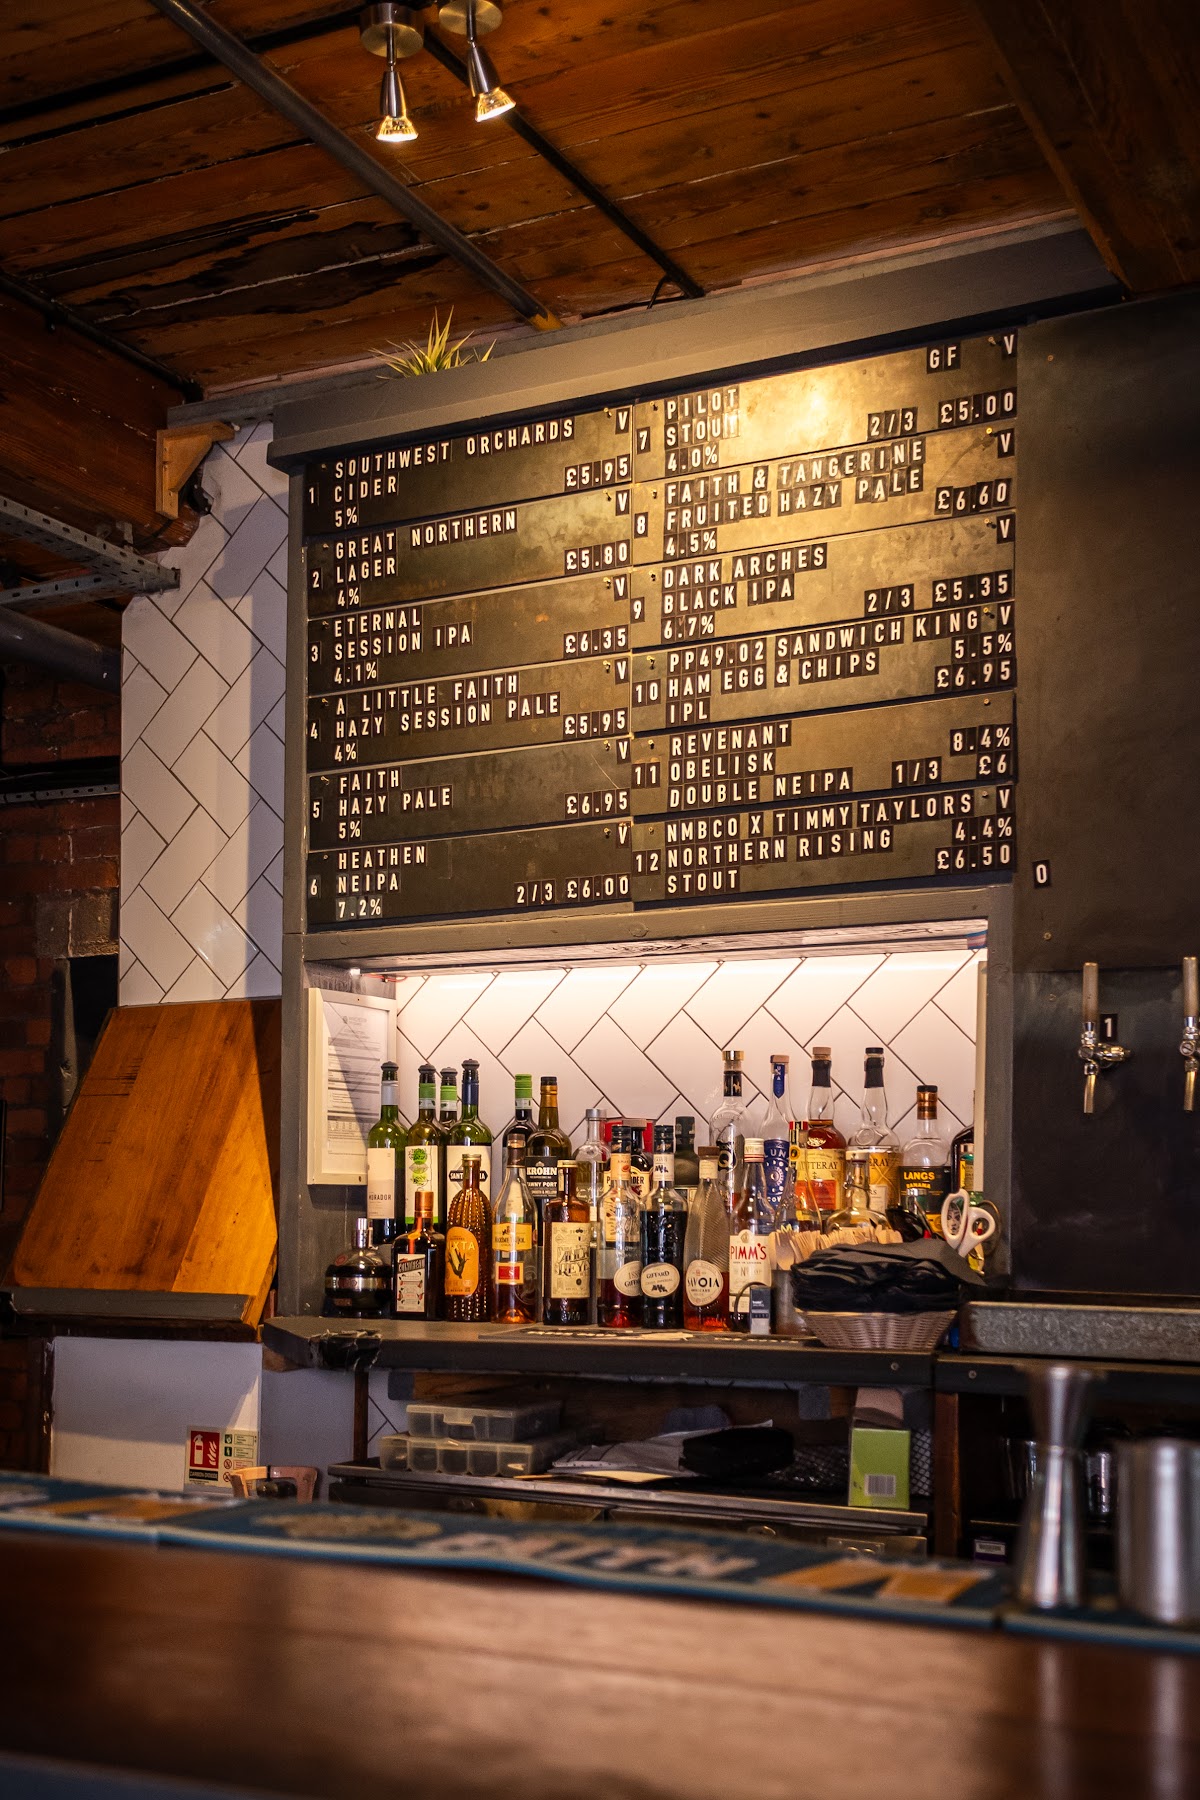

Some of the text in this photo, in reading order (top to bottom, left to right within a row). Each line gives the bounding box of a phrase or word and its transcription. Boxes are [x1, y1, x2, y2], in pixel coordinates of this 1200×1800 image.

[1004, 334, 1014, 355] V
[930, 346, 957, 369] GF
[667, 389, 737, 419] PILOT
[871, 391, 1014, 436] 2/3 £5.00
[618, 412, 628, 430] V
[666, 413, 738, 446] STOUT
[335, 419, 572, 478] SOUTHWEST ORCHARDS
[638, 431, 648, 451] 7
[1001, 434, 1011, 453] V
[667, 445, 718, 472] 4.0%
[566, 458, 628, 486] £5.95
[667, 441, 922, 504] FAITH & TANGERINE
[309, 487, 315, 504] 1
[335, 475, 396, 502] CIDER
[667, 468, 920, 531] FRUITED HAZY PALE
[938, 482, 1008, 511] £6.60
[618, 493, 627, 512] V
[335, 507, 358, 527] 5%
[637, 516, 646, 534] 8
[1000, 519, 1010, 539] V
[335, 511, 516, 559] GREAT NORTHERN
[666, 530, 717, 556] 4.5%
[566, 543, 628, 570] £5.80
[665, 547, 825, 589] DARK ARCHES
[312, 572, 320, 588] 2
[336, 558, 396, 583] LAGER
[338, 588, 359, 607] 4%
[615, 578, 625, 596] V
[664, 578, 792, 614] BLACK IPA
[868, 574, 1008, 612] 2/3 £5.35
[633, 600, 642, 619] 9
[1001, 606, 1010, 625] V
[335, 609, 420, 638] ETERNAL
[663, 615, 714, 639] 6.7%
[335, 625, 470, 660] SESSION IPA
[565, 628, 626, 654] £6.35
[670, 610, 978, 672] PP49.02 SANDWICH KING
[955, 634, 1012, 659] 5.5%
[311, 646, 318, 663] 3
[335, 662, 376, 684] 4.1%
[618, 662, 626, 680] V
[669, 651, 876, 698] HAM EGG & CHIPS
[937, 661, 1011, 688] £6.95
[336, 675, 517, 715] A LITTLE FAITH
[636, 682, 658, 703] 10
[336, 694, 558, 738] HAZY SESSION PALE
[565, 710, 626, 735] £5.95
[670, 700, 707, 724] IPL
[311, 723, 318, 739] 4
[671, 723, 790, 756] REVENANT
[953, 727, 1010, 752] 8.4%
[335, 743, 357, 762] 4%
[619, 742, 628, 760] V
[635, 764, 656, 785] 11
[670, 752, 774, 783] OBELISK
[896, 760, 939, 784] 1/3
[979, 754, 1007, 775] £6
[340, 770, 399, 794] FAITH
[670, 771, 850, 808] DOUBLE NEIPA
[313, 802, 320, 818] 5
[339, 787, 450, 817] HAZY PALE
[567, 791, 627, 815] £6.95
[1001, 790, 1010, 810] V
[339, 820, 360, 840] 5%
[667, 794, 971, 844] NMBCO X TIMMY TAYLORS
[955, 817, 1012, 841] 4.4%
[618, 826, 627, 844] V
[339, 846, 425, 870] HEATHEN
[667, 828, 891, 869] NORTHERN RISING
[938, 844, 1010, 870] £6.50
[636, 852, 658, 872] 12
[311, 879, 318, 896] 6
[338, 873, 398, 894] NEIPA
[516, 876, 629, 904] 2/3 £6.00
[667, 869, 738, 894] STOUT
[338, 899, 381, 918] 7.2%
[1104, 1017, 1113, 1037] 1
[904, 1172, 935, 1180] LANGS
[731, 1243, 767, 1260] PIMM'S
